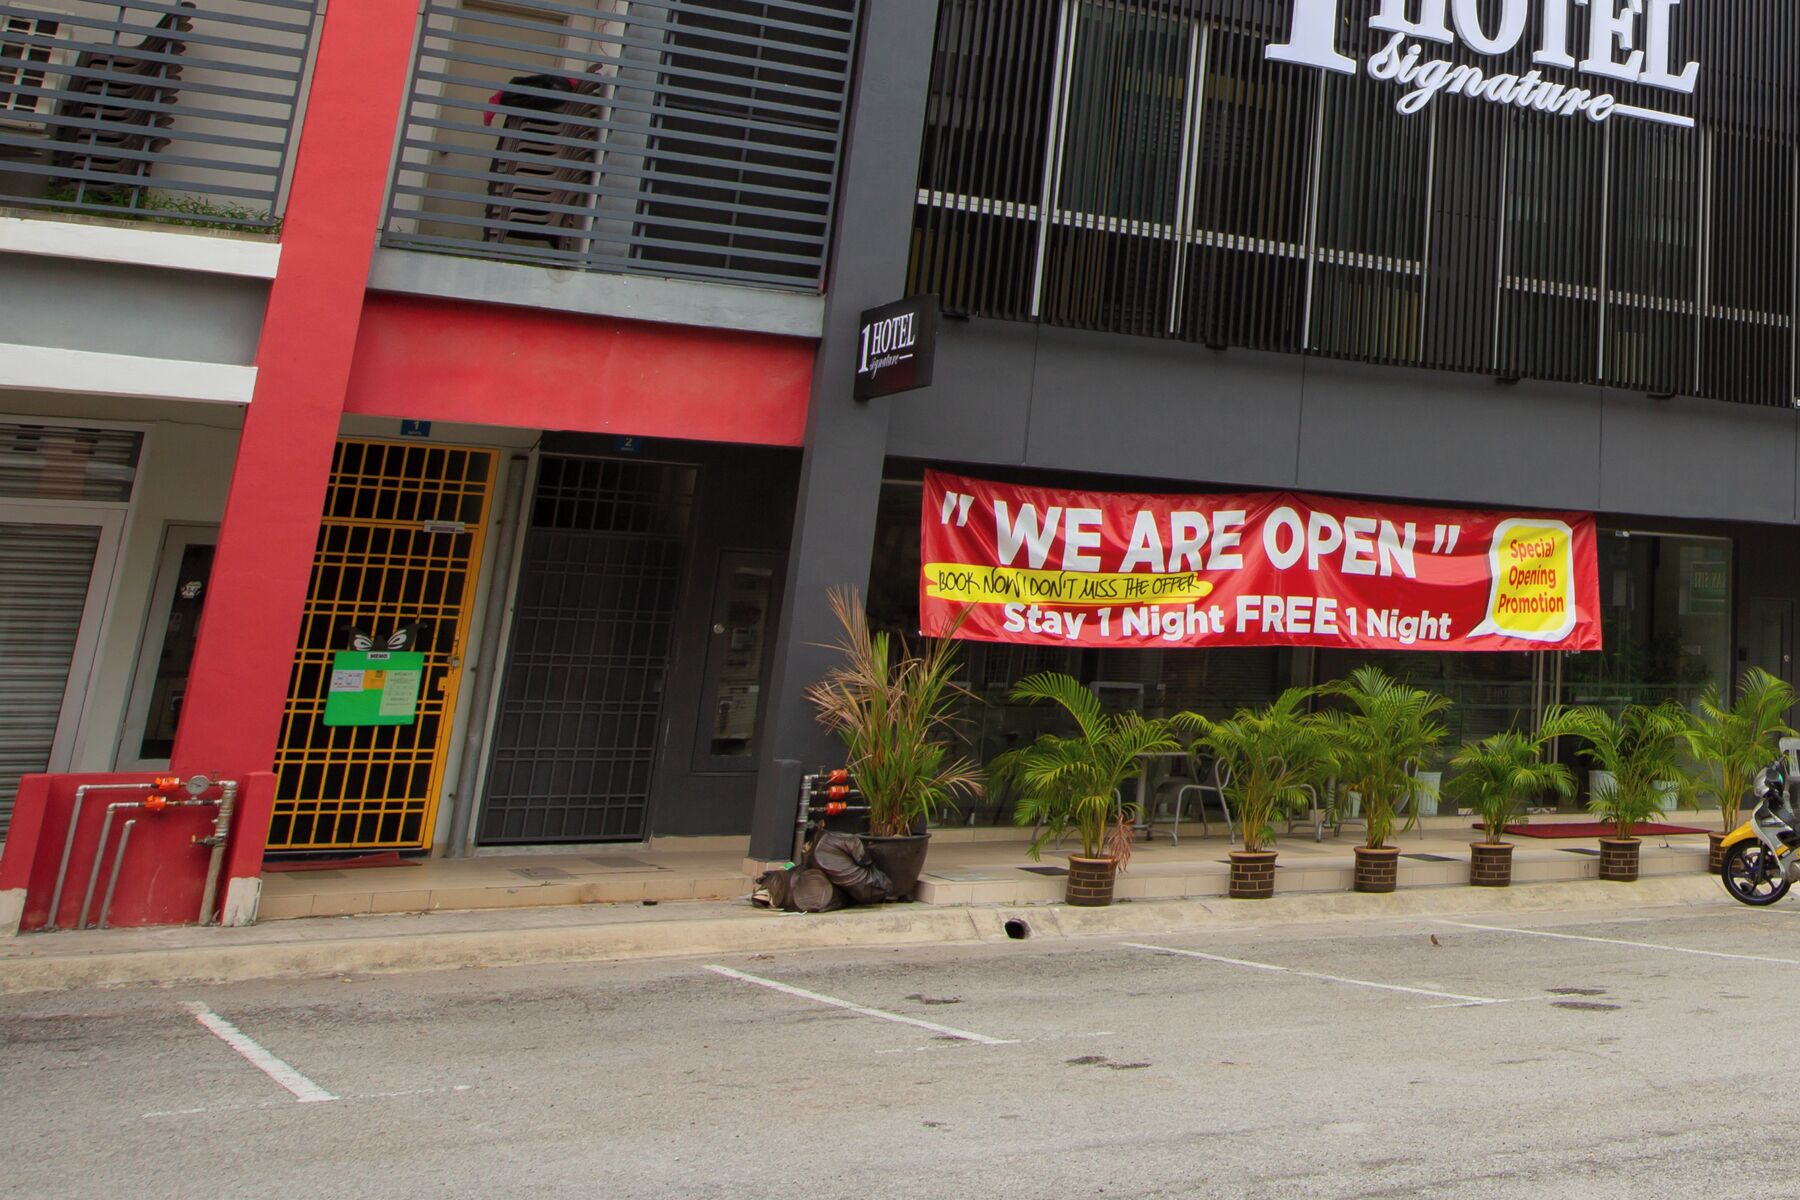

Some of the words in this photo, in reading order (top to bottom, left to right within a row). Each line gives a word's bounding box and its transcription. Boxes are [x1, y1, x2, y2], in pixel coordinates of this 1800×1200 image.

[858, 323, 871, 374] 1
[871, 312, 916, 355] HOTEL
[624, 436, 633, 447] 2
[993, 500, 1103, 573] WE
[1118, 509, 1246, 573] ARE
[1262, 506, 1417, 578] OPEN
[1509, 537, 1556, 562] Special
[937, 569, 982, 594] BOOK
[1029, 570, 1077, 598] DON'T
[1079, 578, 1118, 600] MISS
[1124, 577, 1150, 598] THE
[1151, 572, 1201, 596] OFFER
[1508, 564, 1557, 590] Opening
[1497, 592, 1564, 614] Promotion
[1003, 601, 1087, 640] Stay
[1097, 607, 1112, 637] 1
[1122, 604, 1225, 641] Night
[1235, 595, 1339, 635] FREE
[1345, 607, 1357, 636] 1
[1366, 608, 1452, 645] Night
